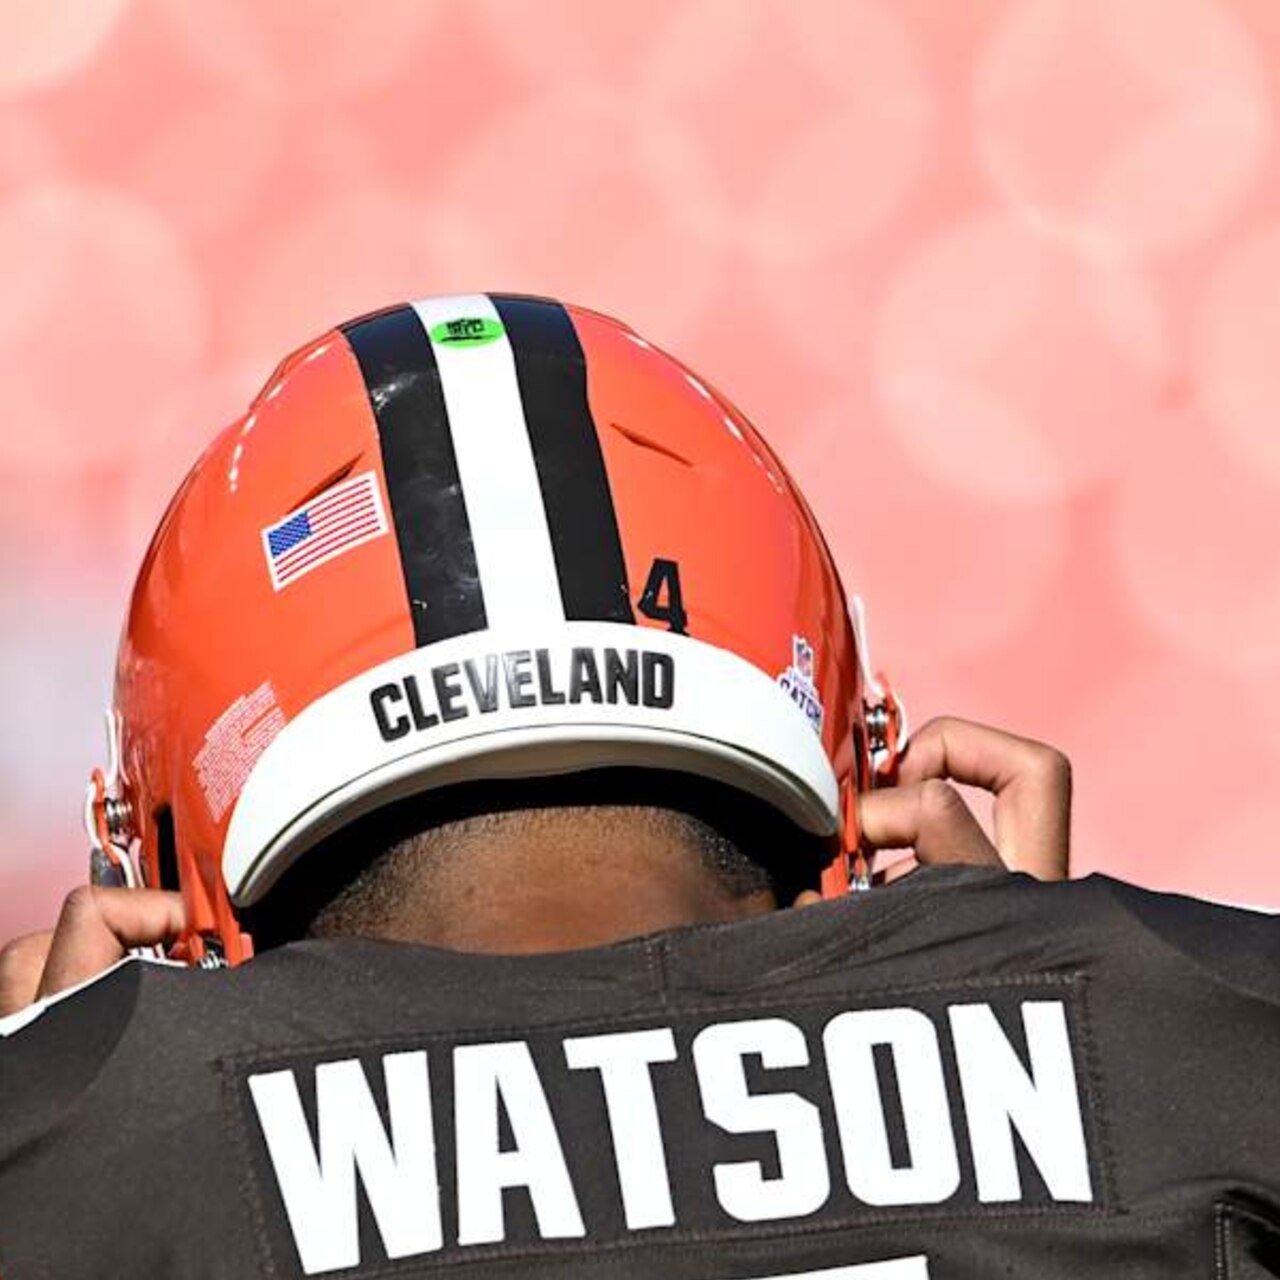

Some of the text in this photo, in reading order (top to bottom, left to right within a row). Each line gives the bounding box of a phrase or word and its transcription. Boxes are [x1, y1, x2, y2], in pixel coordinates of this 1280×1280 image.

[637, 558, 690, 637] 4
[369, 648, 675, 742] CLEVELAND
[248, 1001, 1093, 1274] WATSON
